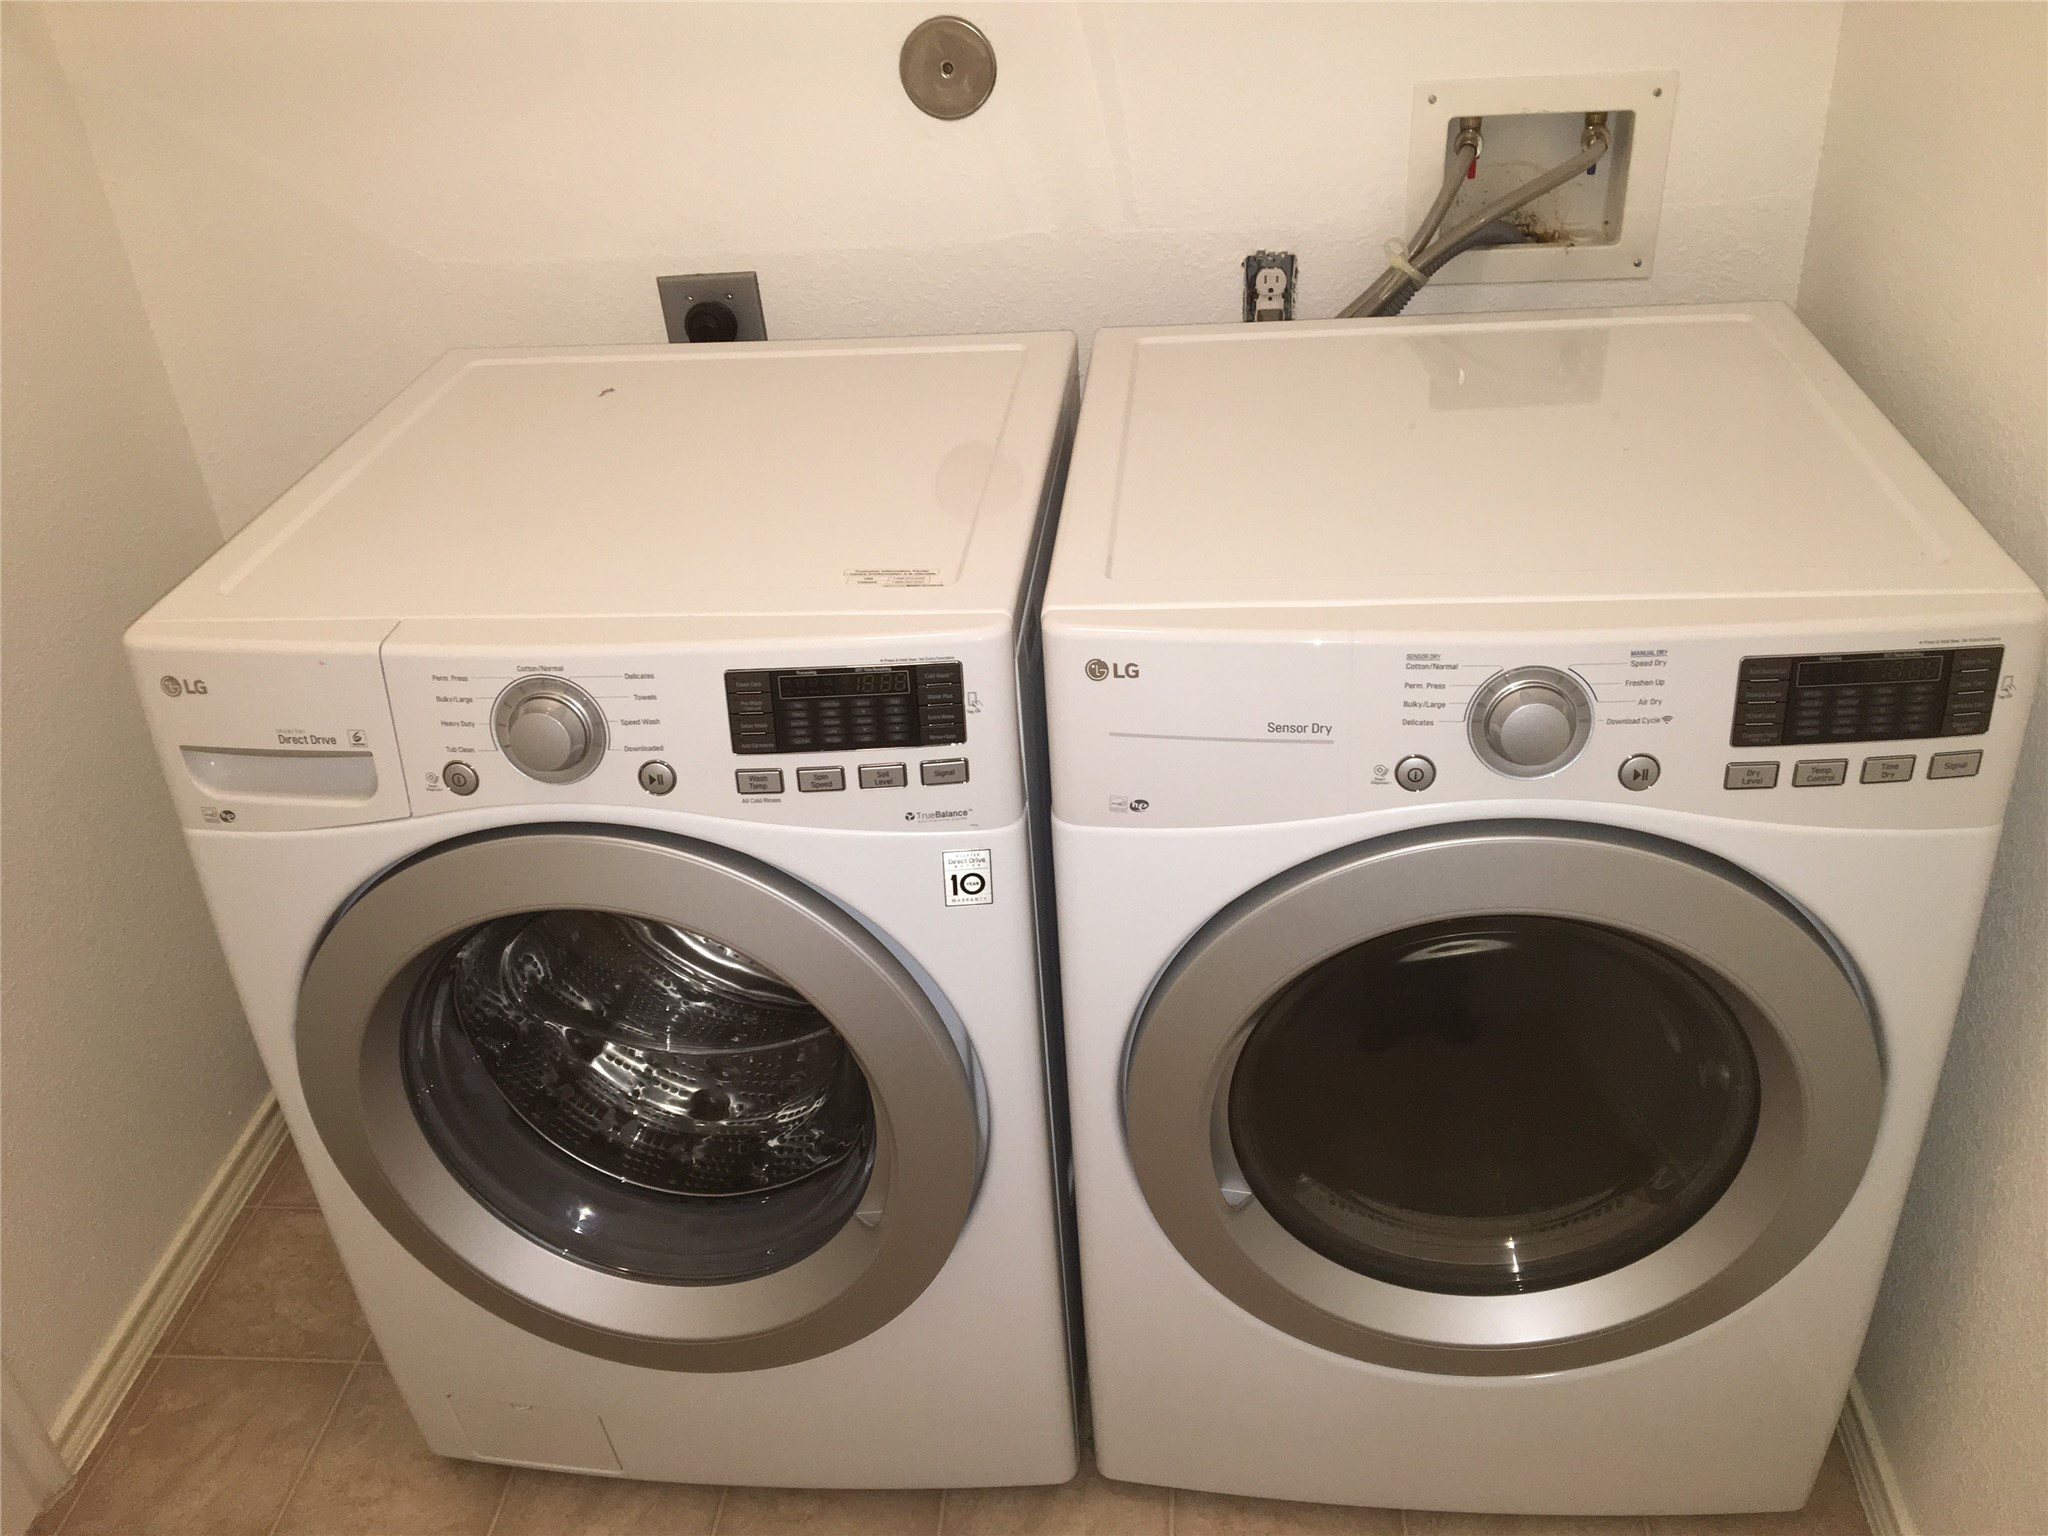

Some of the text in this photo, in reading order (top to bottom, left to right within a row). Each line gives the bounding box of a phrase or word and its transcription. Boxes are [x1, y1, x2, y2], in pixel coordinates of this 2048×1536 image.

[1654, 659, 1667, 667] Dry
[1113, 662, 1140, 679] LG
[451, 674, 469, 682] Press
[184, 679, 208, 695] LG
[1404, 682, 1446, 690] Perm. Press
[1655, 679, 1665, 687] Up
[435, 695, 473, 704] Bulky/Large
[633, 693, 657, 701] Towels
[1403, 701, 1446, 709] Bulky/Large
[1650, 698, 1663, 706] Dry
[440, 720, 475, 728] Heavy Duty
[620, 719, 641, 727] Speed
[1641, 717, 1661, 725] Cycle
[1267, 721, 1333, 736] Sensor Dry
[278, 733, 337, 745] Direct Drive
[1944, 762, 1968, 770] Signal
[934, 769, 956, 777] Signal
[1746, 769, 1761, 778] Dry
[1881, 771, 1896, 779] Dry
[875, 778, 893, 786] Level
[1807, 774, 1835, 782] Control
[811, 781, 833, 789] Speed
[950, 872, 986, 896] 10
